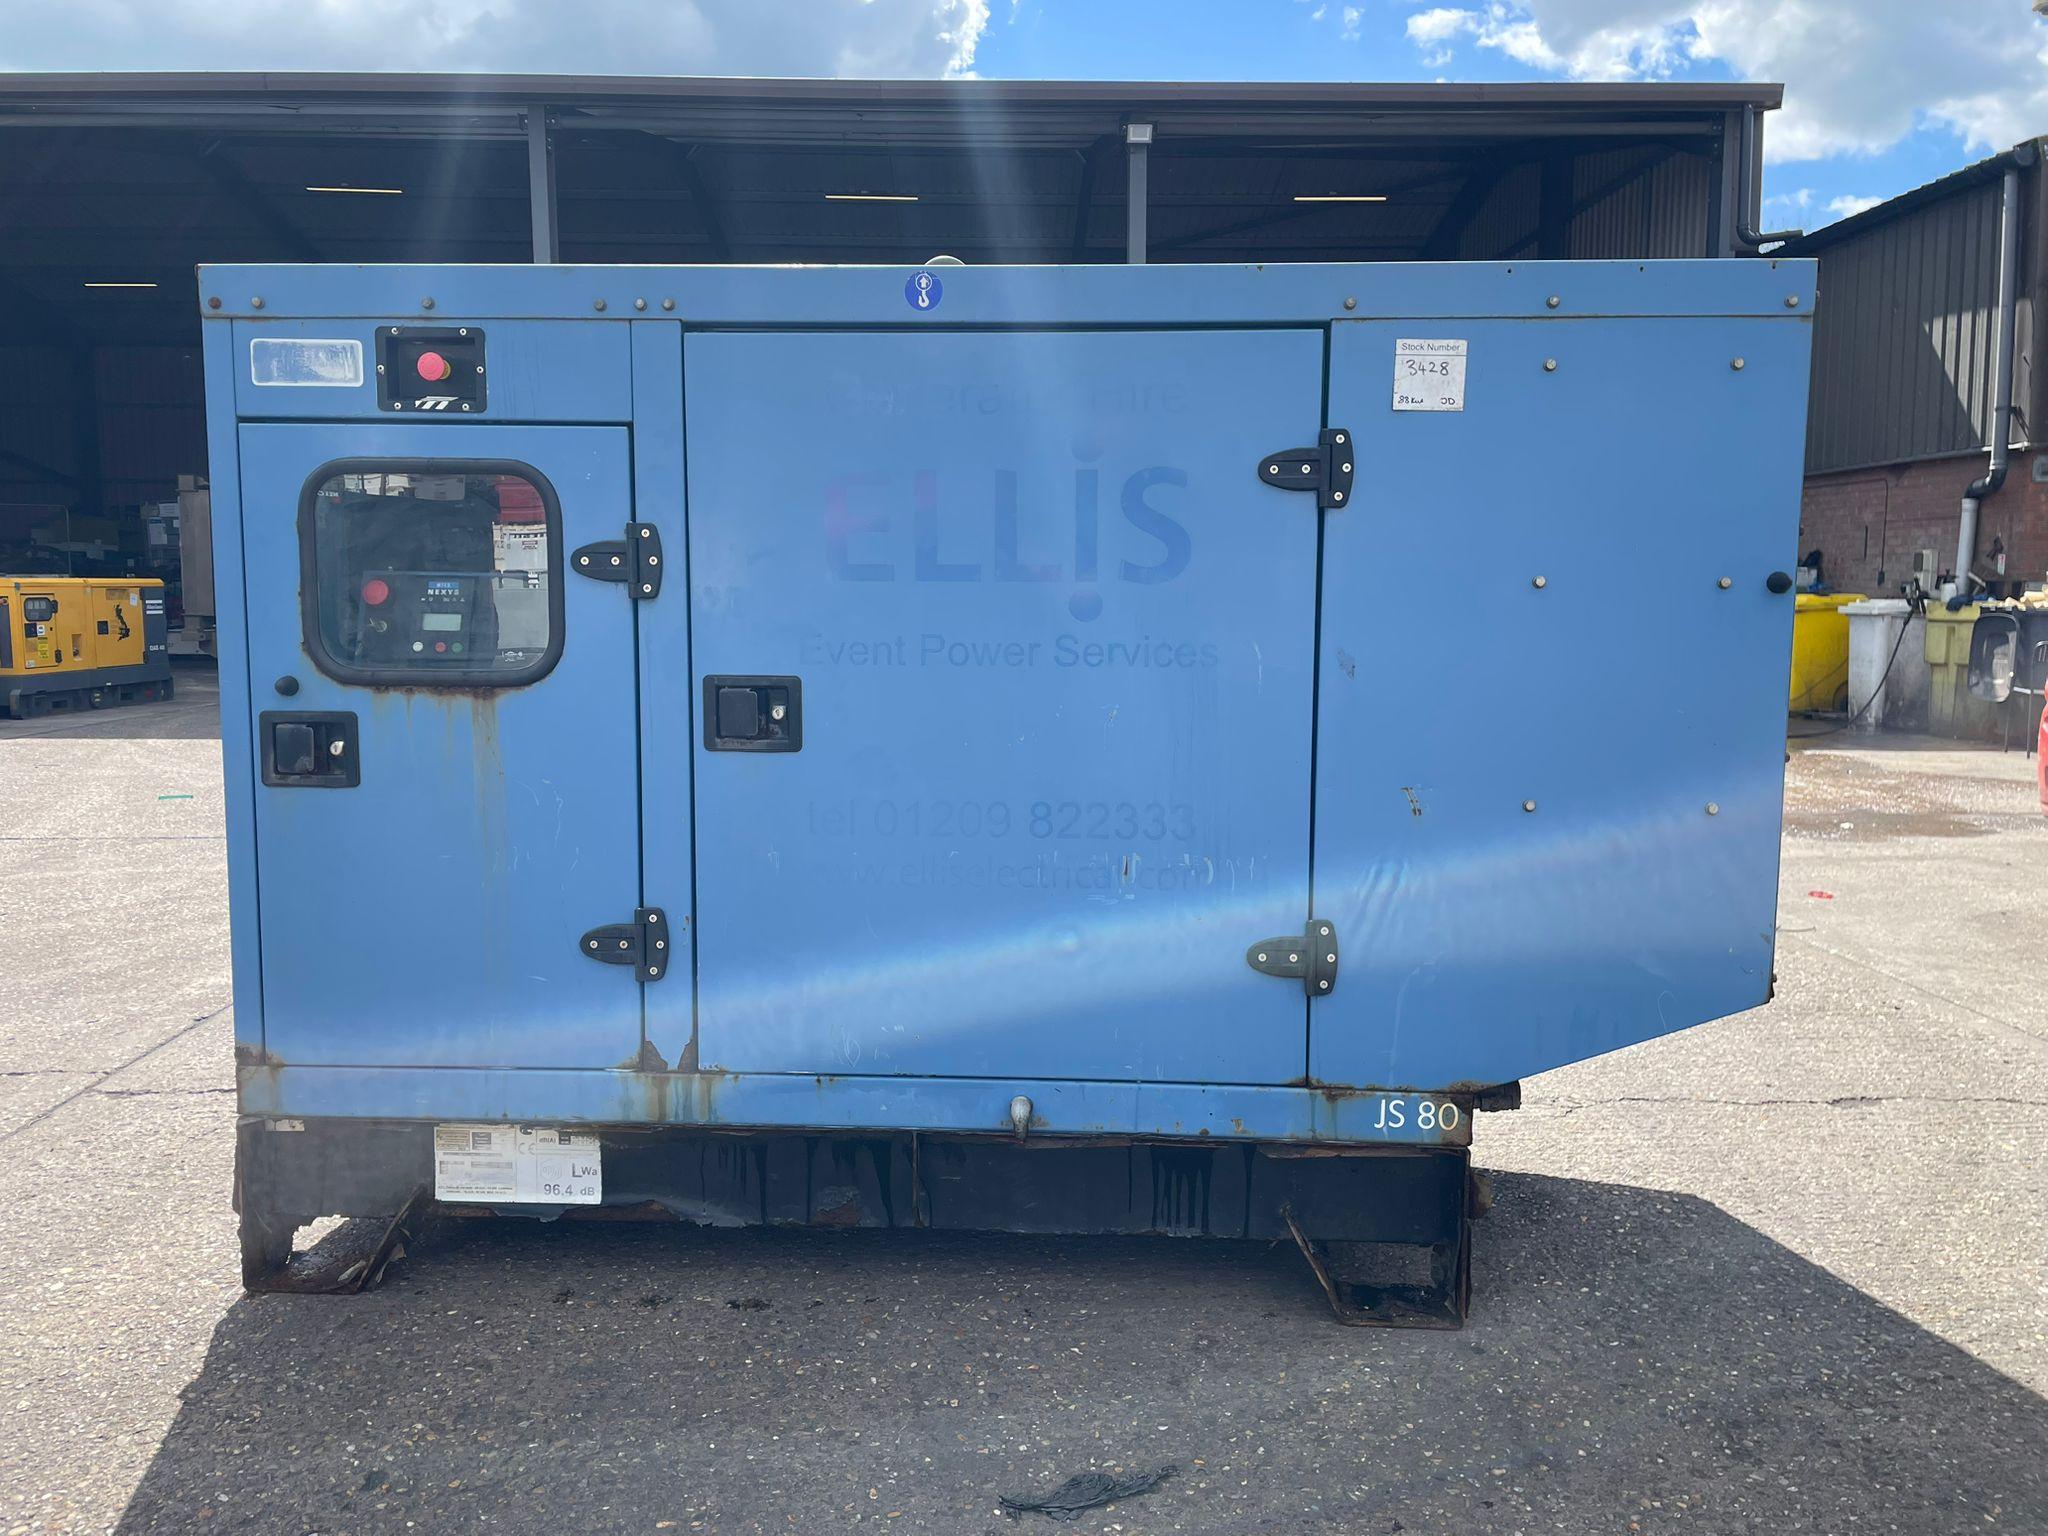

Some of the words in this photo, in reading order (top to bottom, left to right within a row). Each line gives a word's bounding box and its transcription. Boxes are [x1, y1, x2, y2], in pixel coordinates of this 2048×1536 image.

[1401, 342, 1425, 351] Stock
[1426, 343, 1461, 352] Number
[1405, 359, 1450, 377] 3428
[800, 633, 907, 667] Event
[919, 633, 1042, 667] Power
[1053, 634, 1221, 668] Services
[806, 800, 858, 837] tel
[873, 800, 1012, 839] 01209
[1028, 801, 1198, 841] 822333
[1373, 1099, 1406, 1129] JS
[1417, 1101, 1459, 1131] 80
[543, 1183, 574, 1197] 96.4
[580, 1186, 596, 1197] dB
